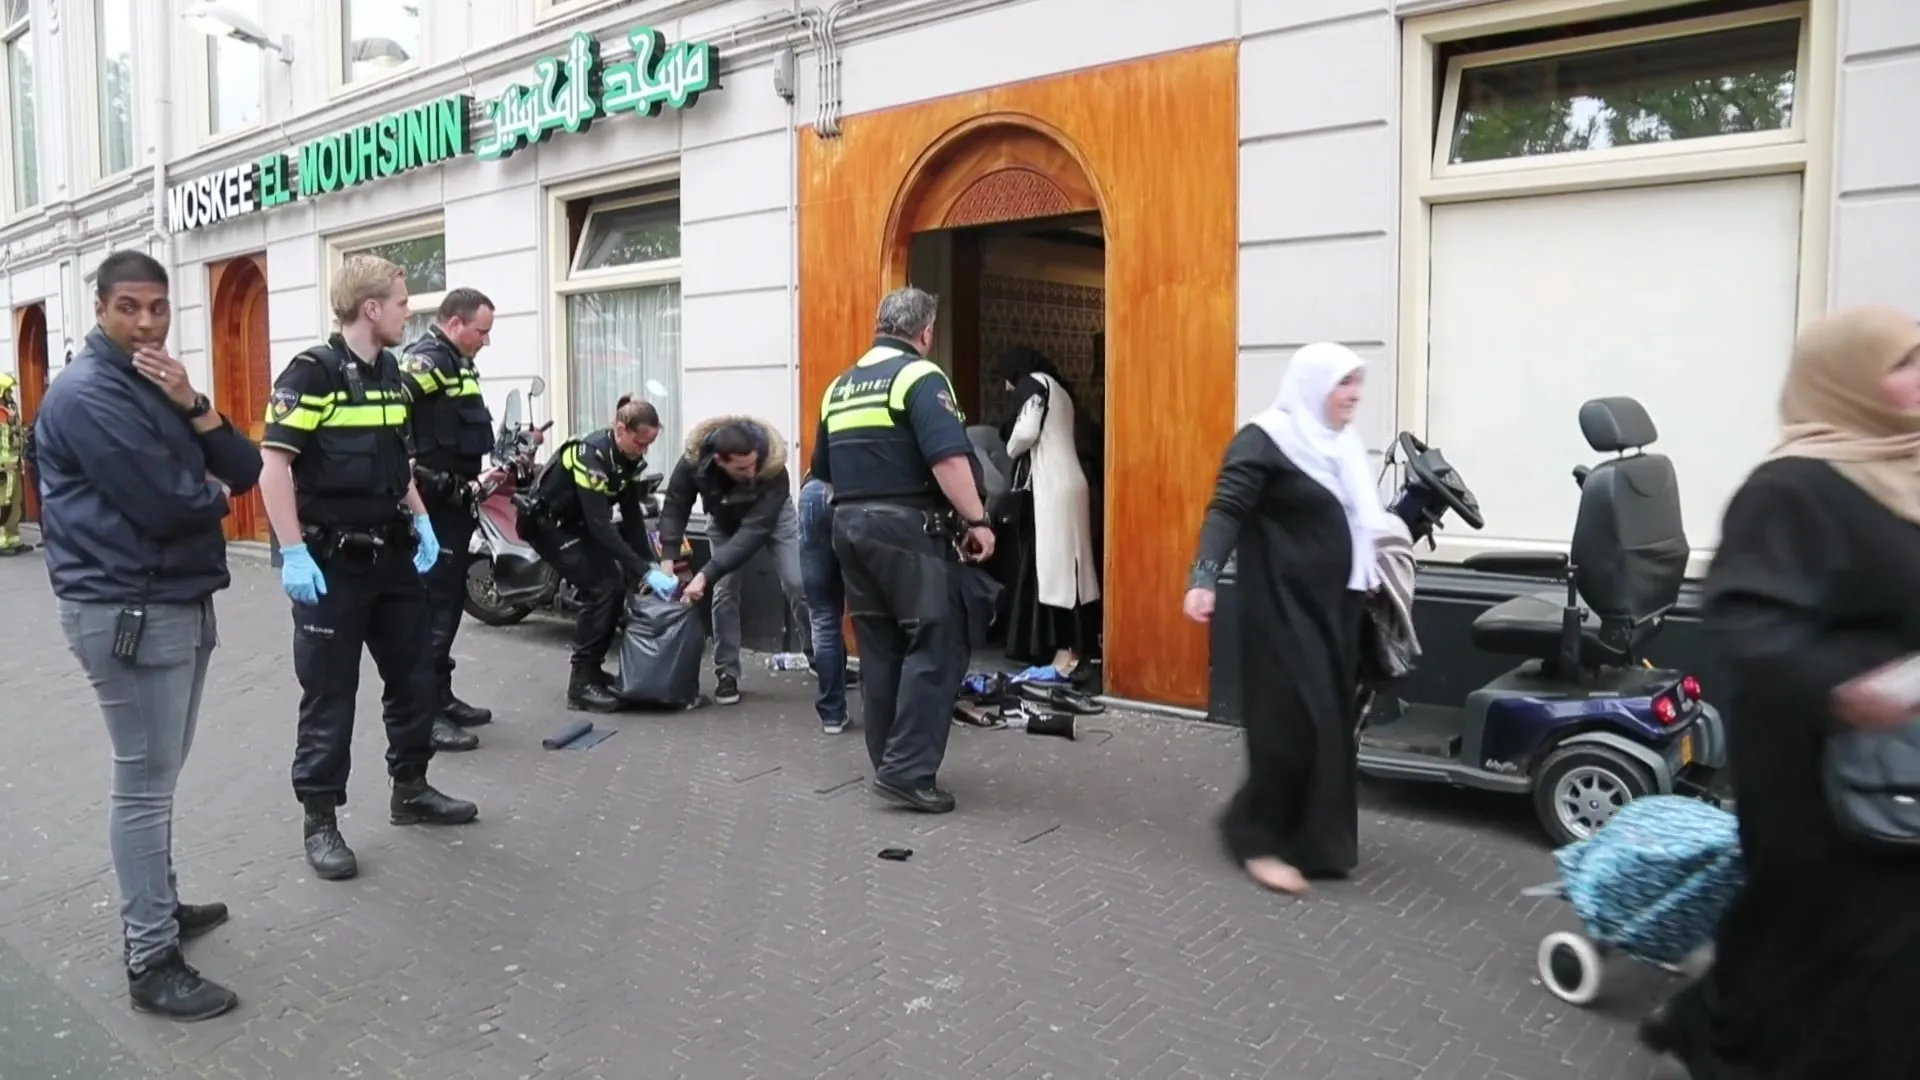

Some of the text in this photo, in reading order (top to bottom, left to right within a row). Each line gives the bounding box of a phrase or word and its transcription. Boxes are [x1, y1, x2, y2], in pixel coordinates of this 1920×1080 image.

[476, 25, 710, 161] مسجد المحسنين
[167, 94, 463, 233] MOSKEE EL MOUHSININ
